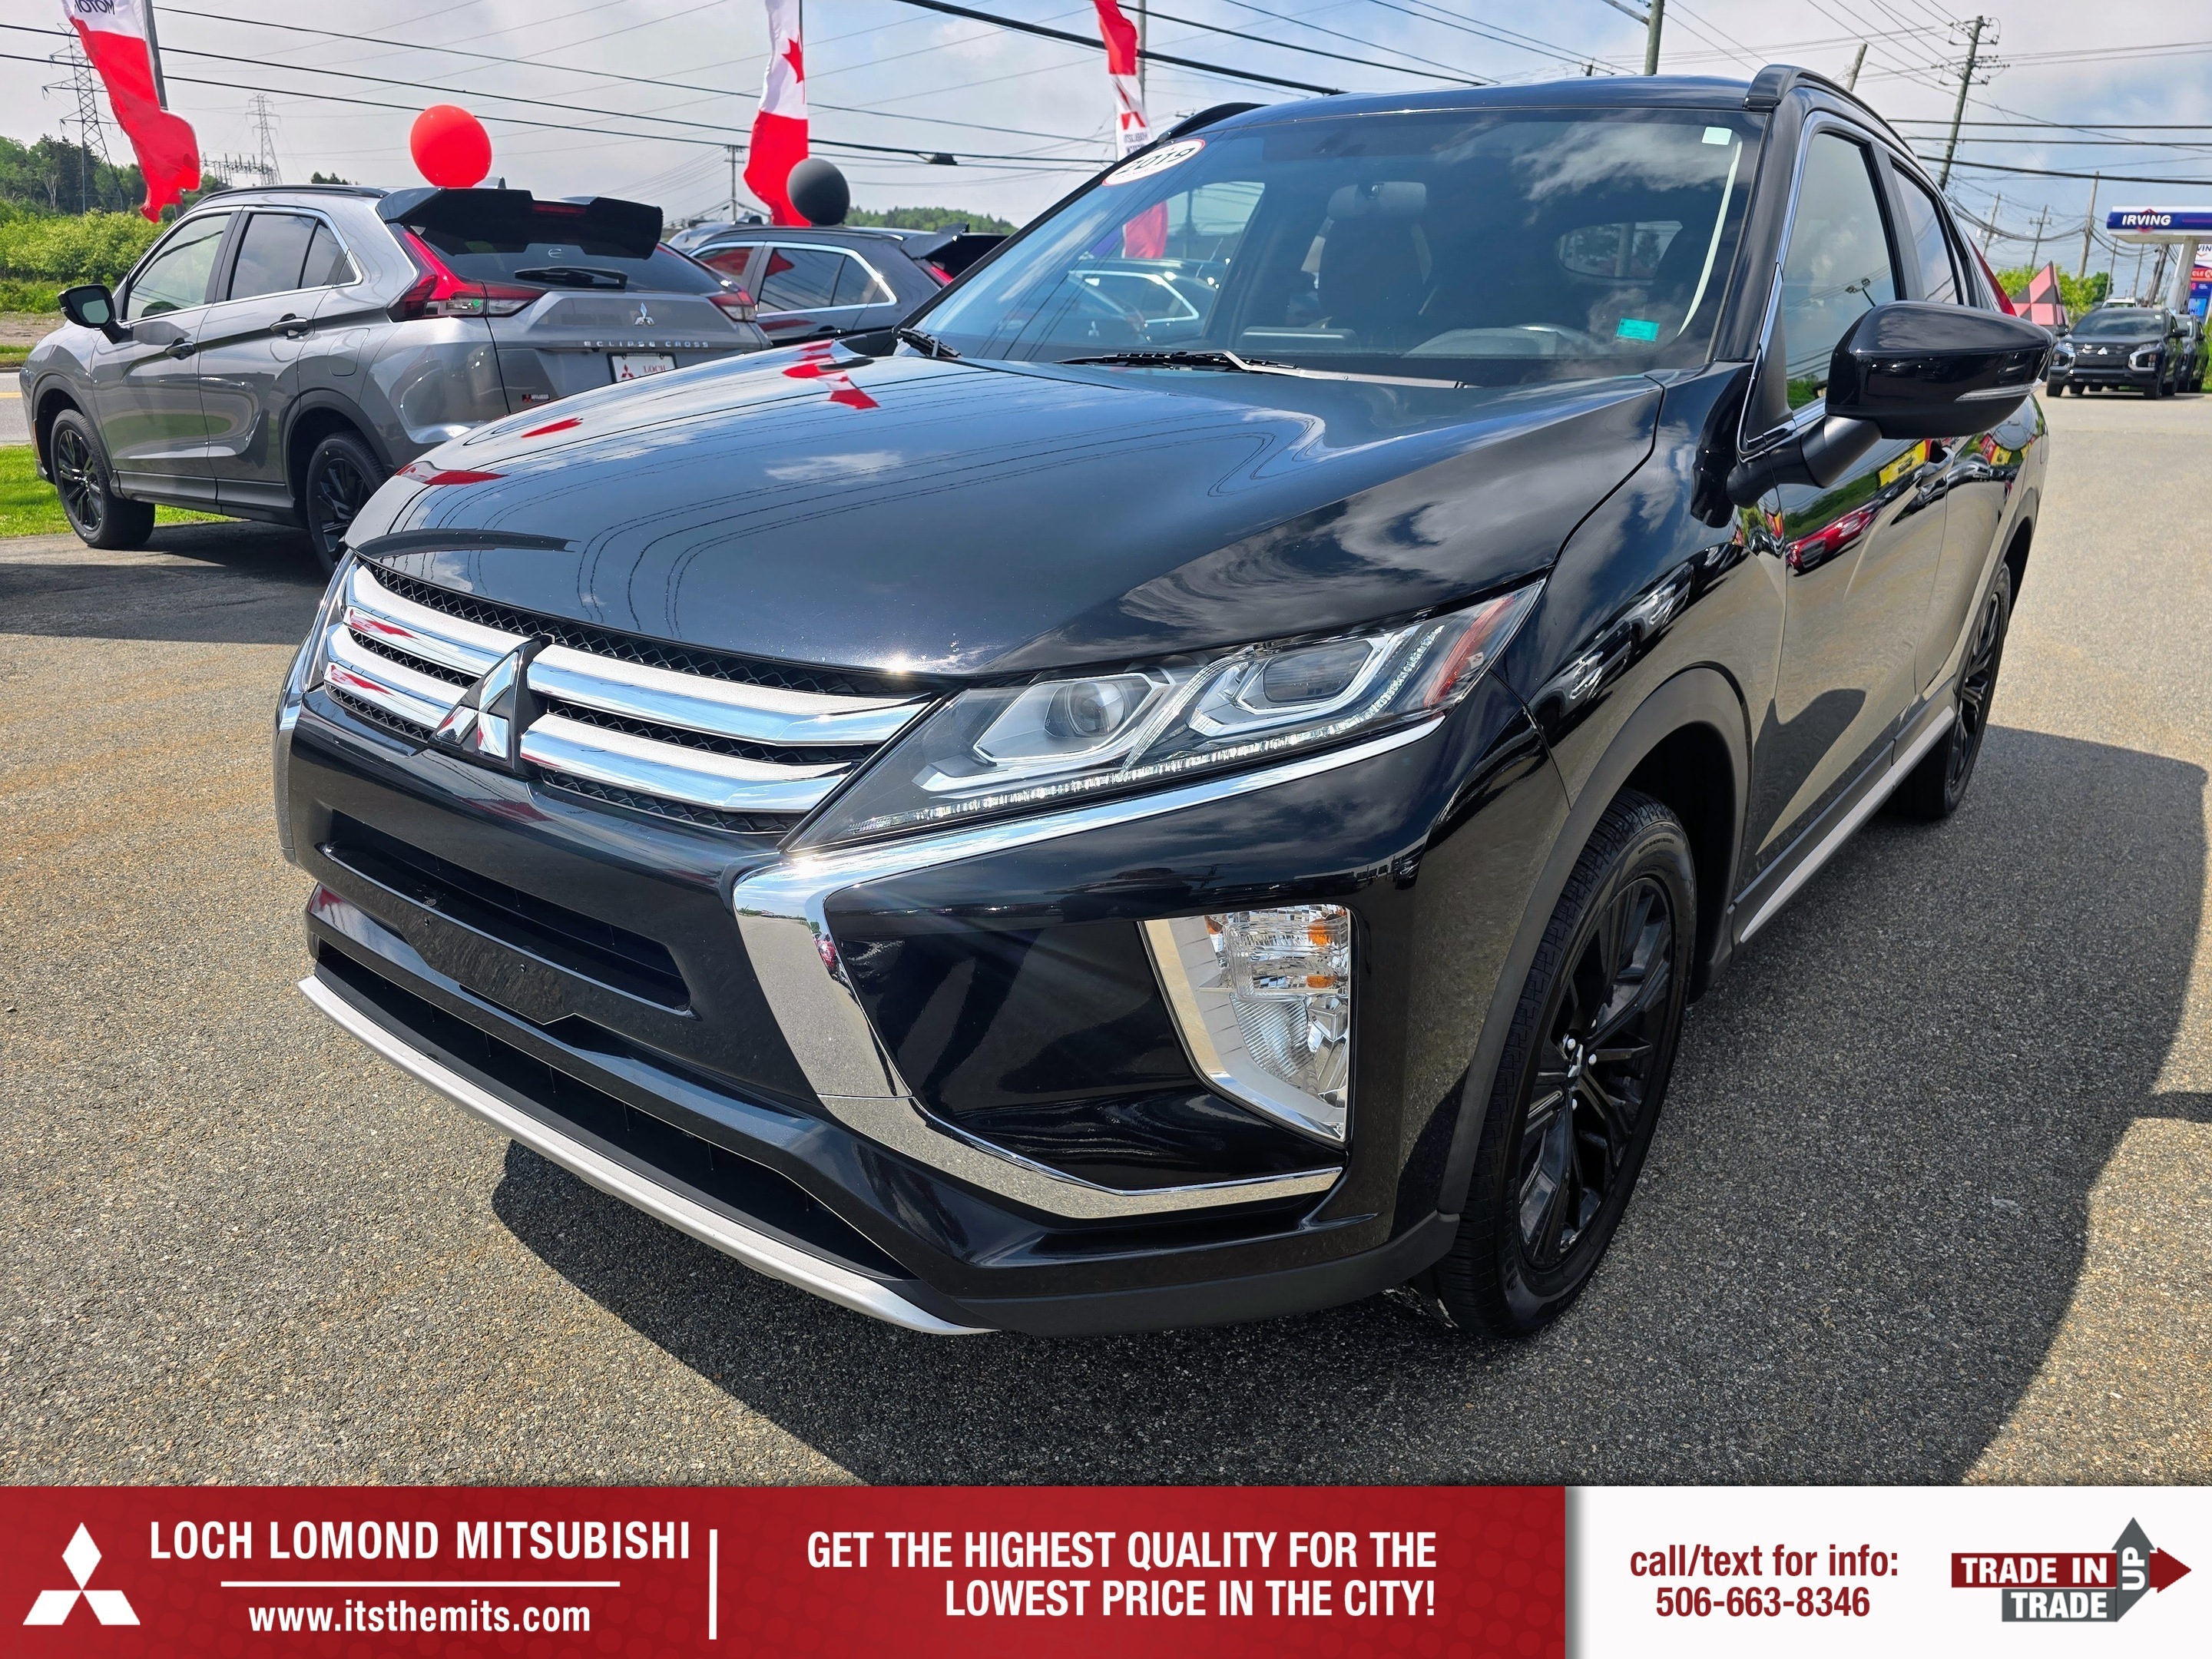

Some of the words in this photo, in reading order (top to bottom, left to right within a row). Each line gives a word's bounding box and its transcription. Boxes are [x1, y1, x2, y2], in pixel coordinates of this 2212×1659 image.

[1114, 146, 1197, 177] 2019
[2122, 214, 2171, 226] IRVING
[644, 365, 666, 374] LOCH
